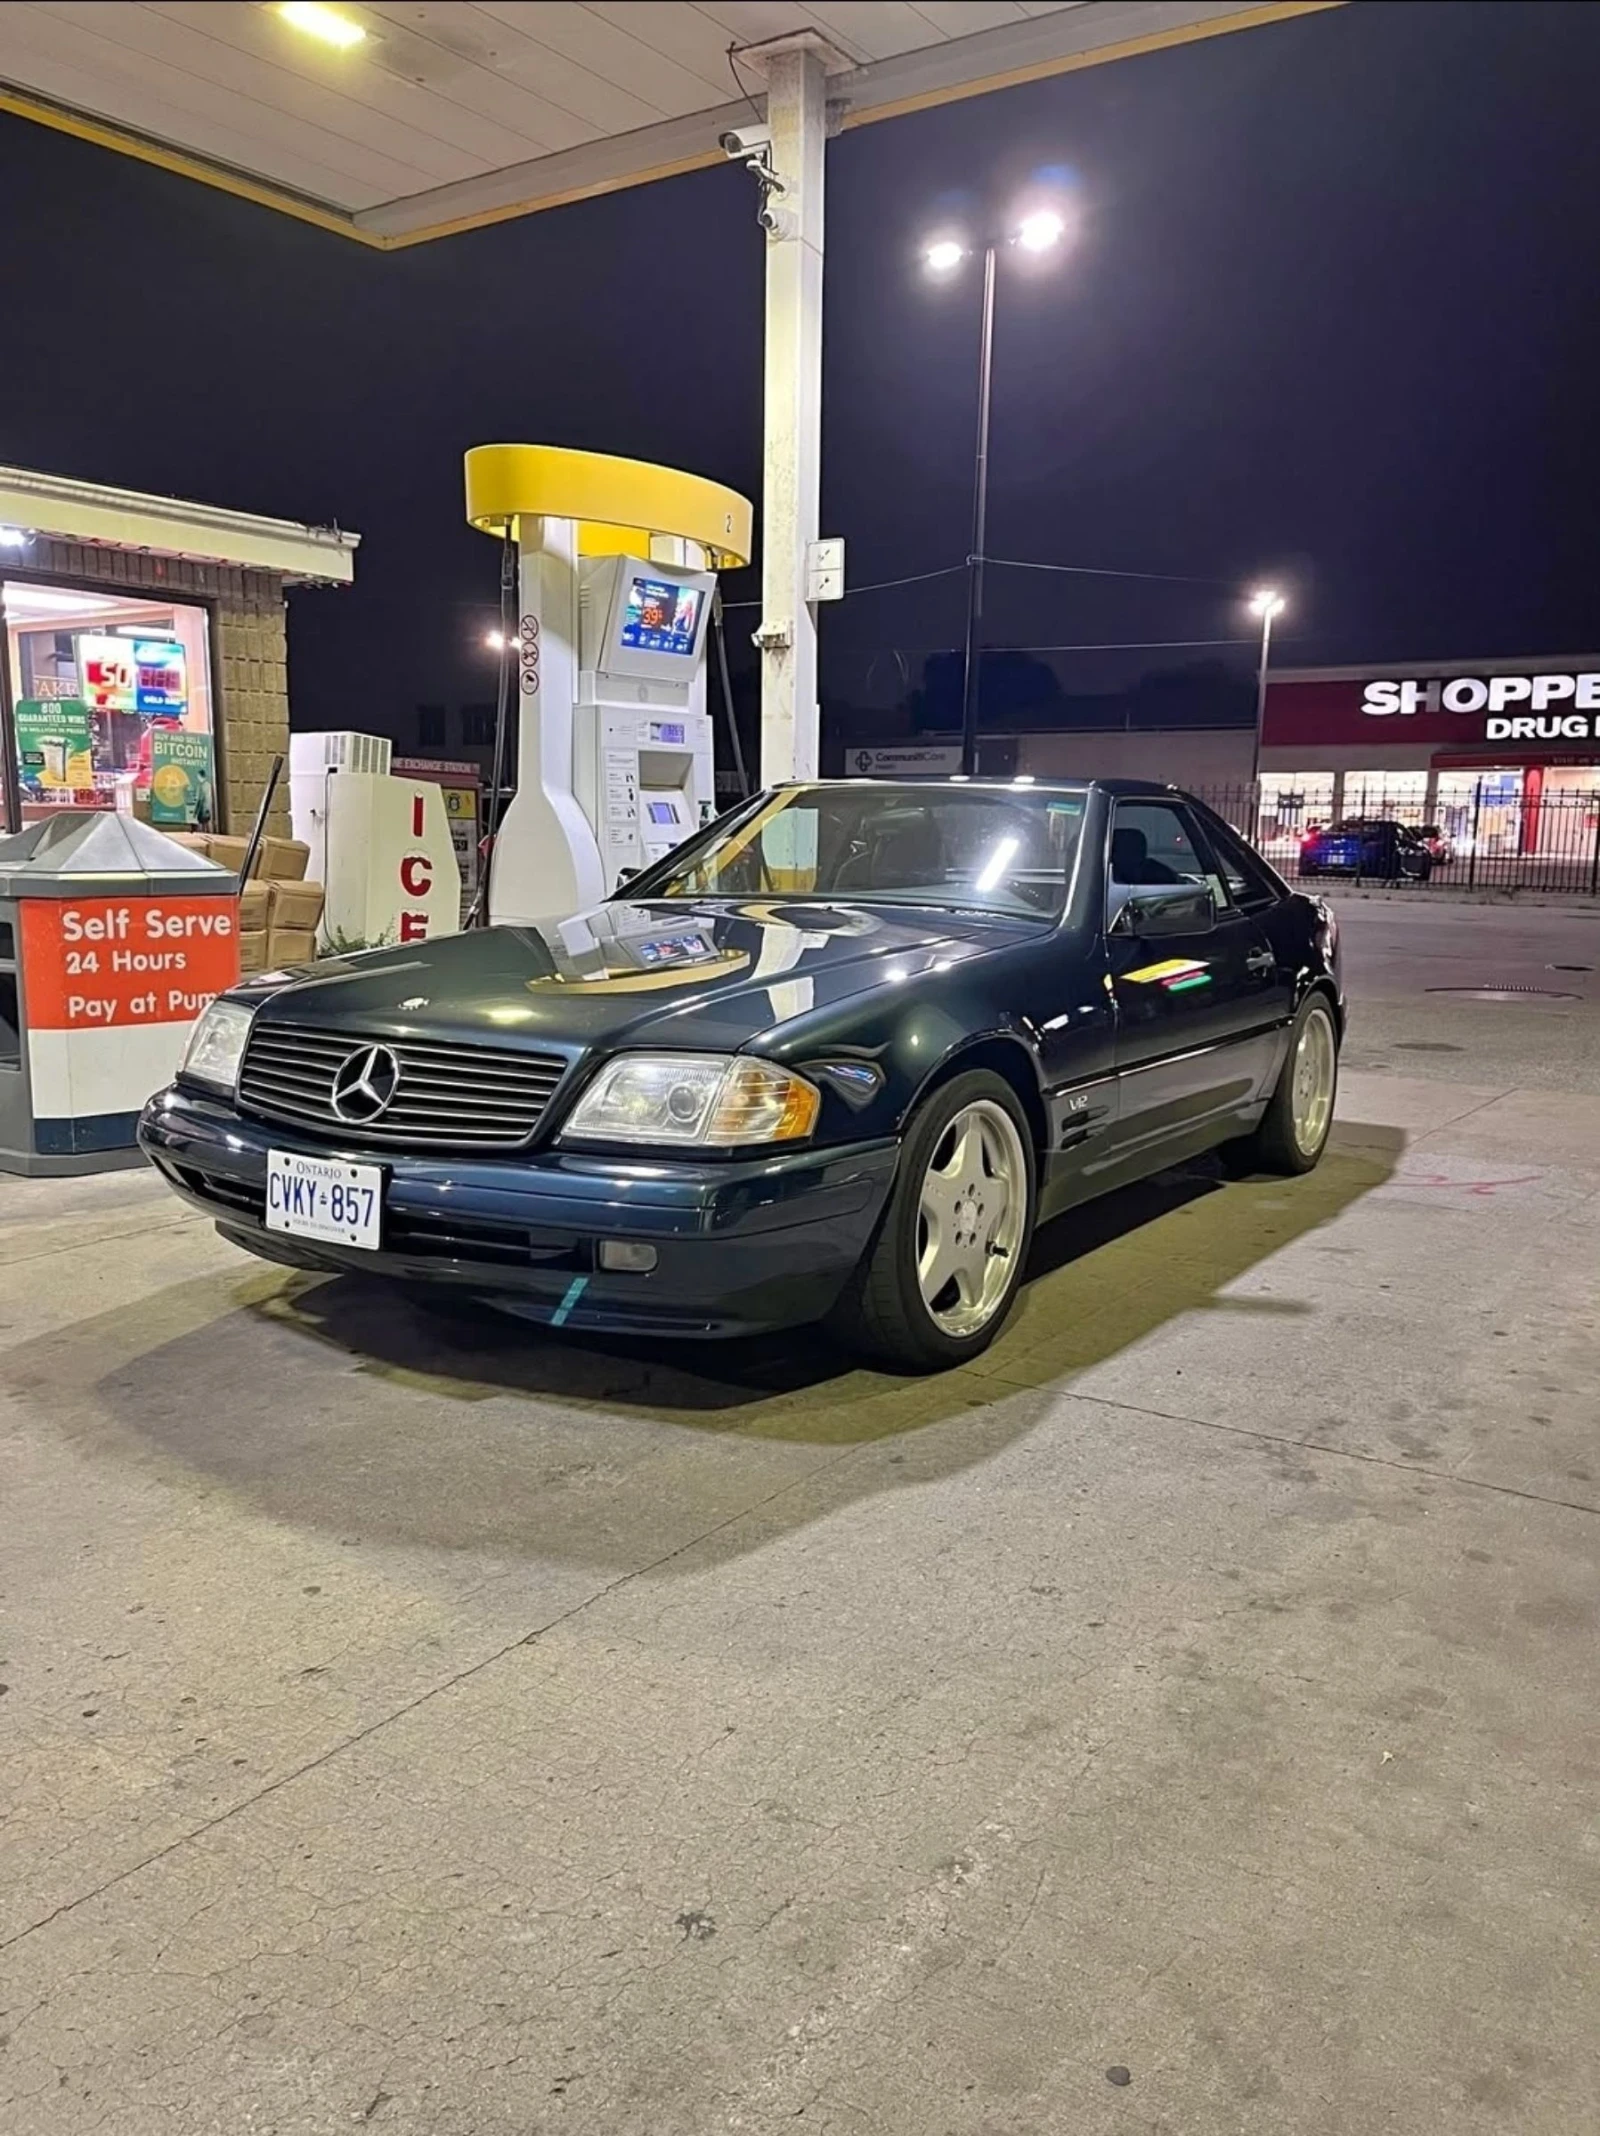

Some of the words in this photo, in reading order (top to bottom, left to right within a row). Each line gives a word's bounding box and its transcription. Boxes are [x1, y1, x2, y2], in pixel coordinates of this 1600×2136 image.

[1361, 674, 1600, 716] SHOPPE
[170, 734, 185, 743] AND
[1486, 715, 1589, 740] DRUG
[154, 741, 208, 759] BITCOIN
[63, 908, 130, 941] Self
[145, 909, 231, 938] Serve
[66, 951, 100, 974] 24
[112, 949, 187, 972] Hours
[69, 995, 117, 1023] Pay
[130, 992, 157, 1013] at
[168, 989, 222, 1011] Pum
[296, 1161, 342, 1179] ONTARIO
